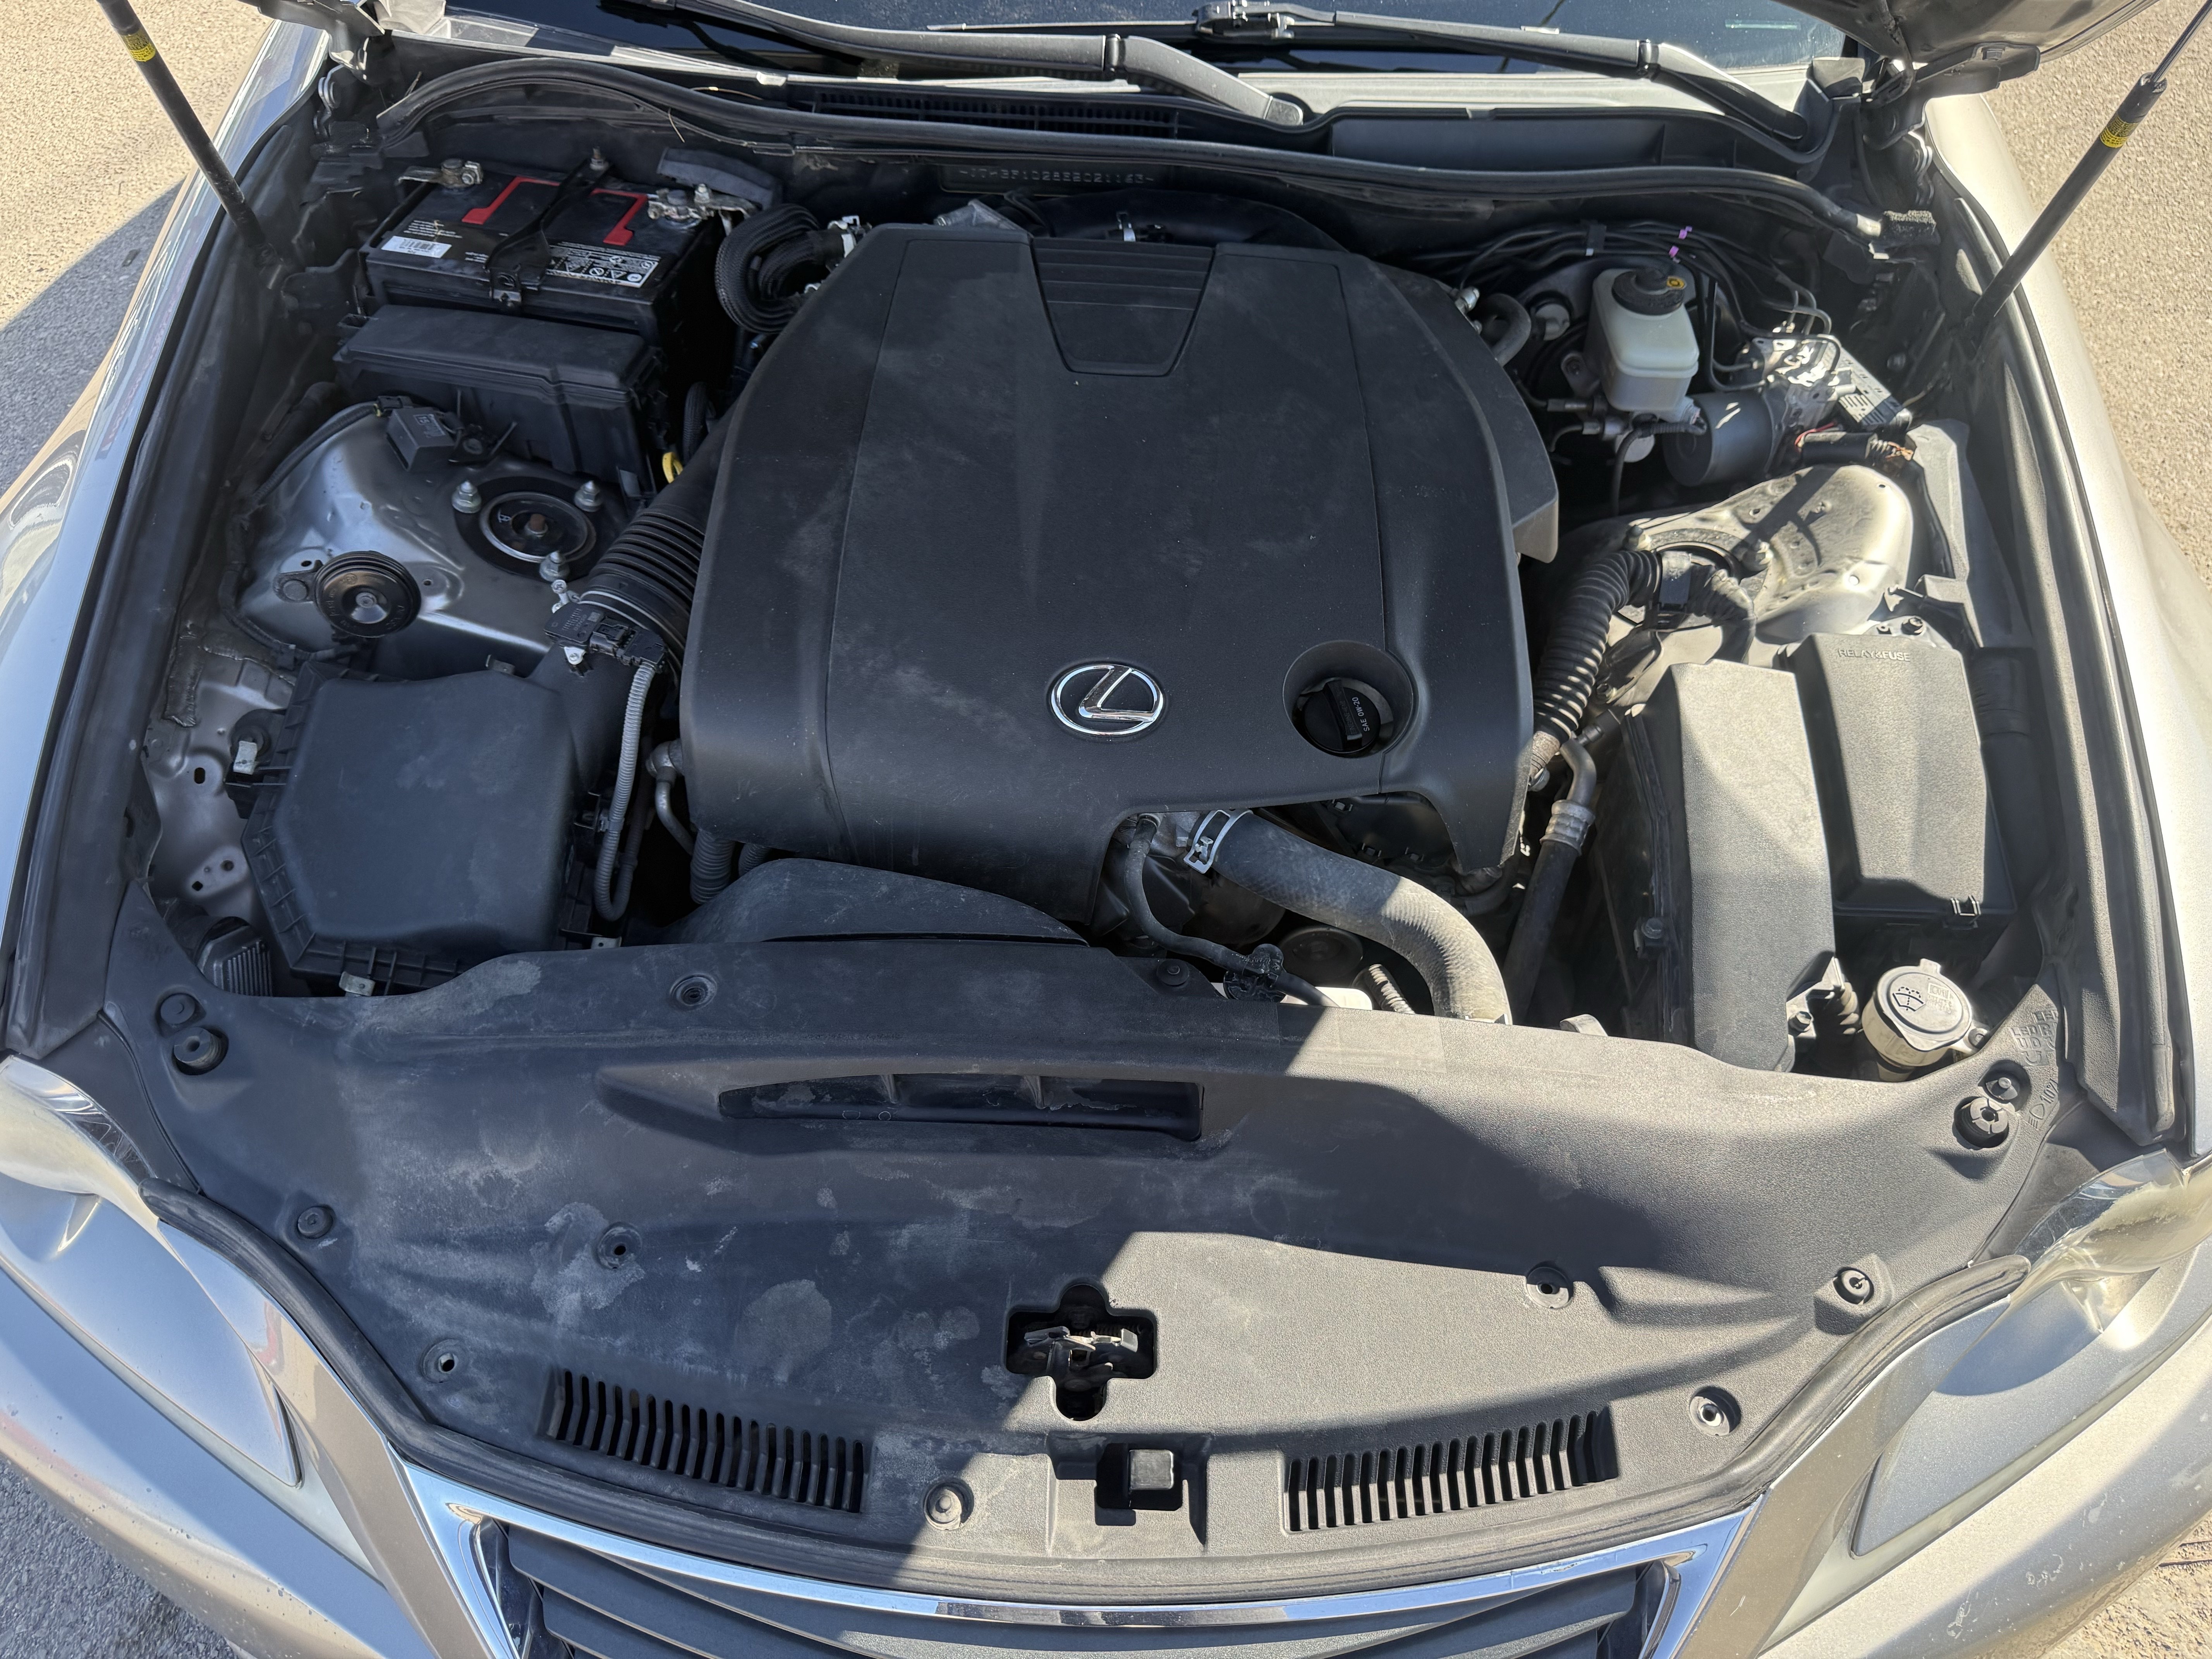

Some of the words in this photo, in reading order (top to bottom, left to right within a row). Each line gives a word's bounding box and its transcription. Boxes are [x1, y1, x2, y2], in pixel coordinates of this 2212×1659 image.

[1838, 649, 1910, 662] RELAY&FUSE
[1352, 697, 1364, 716] 0W-20
[1360, 718, 1370, 732] SAE
